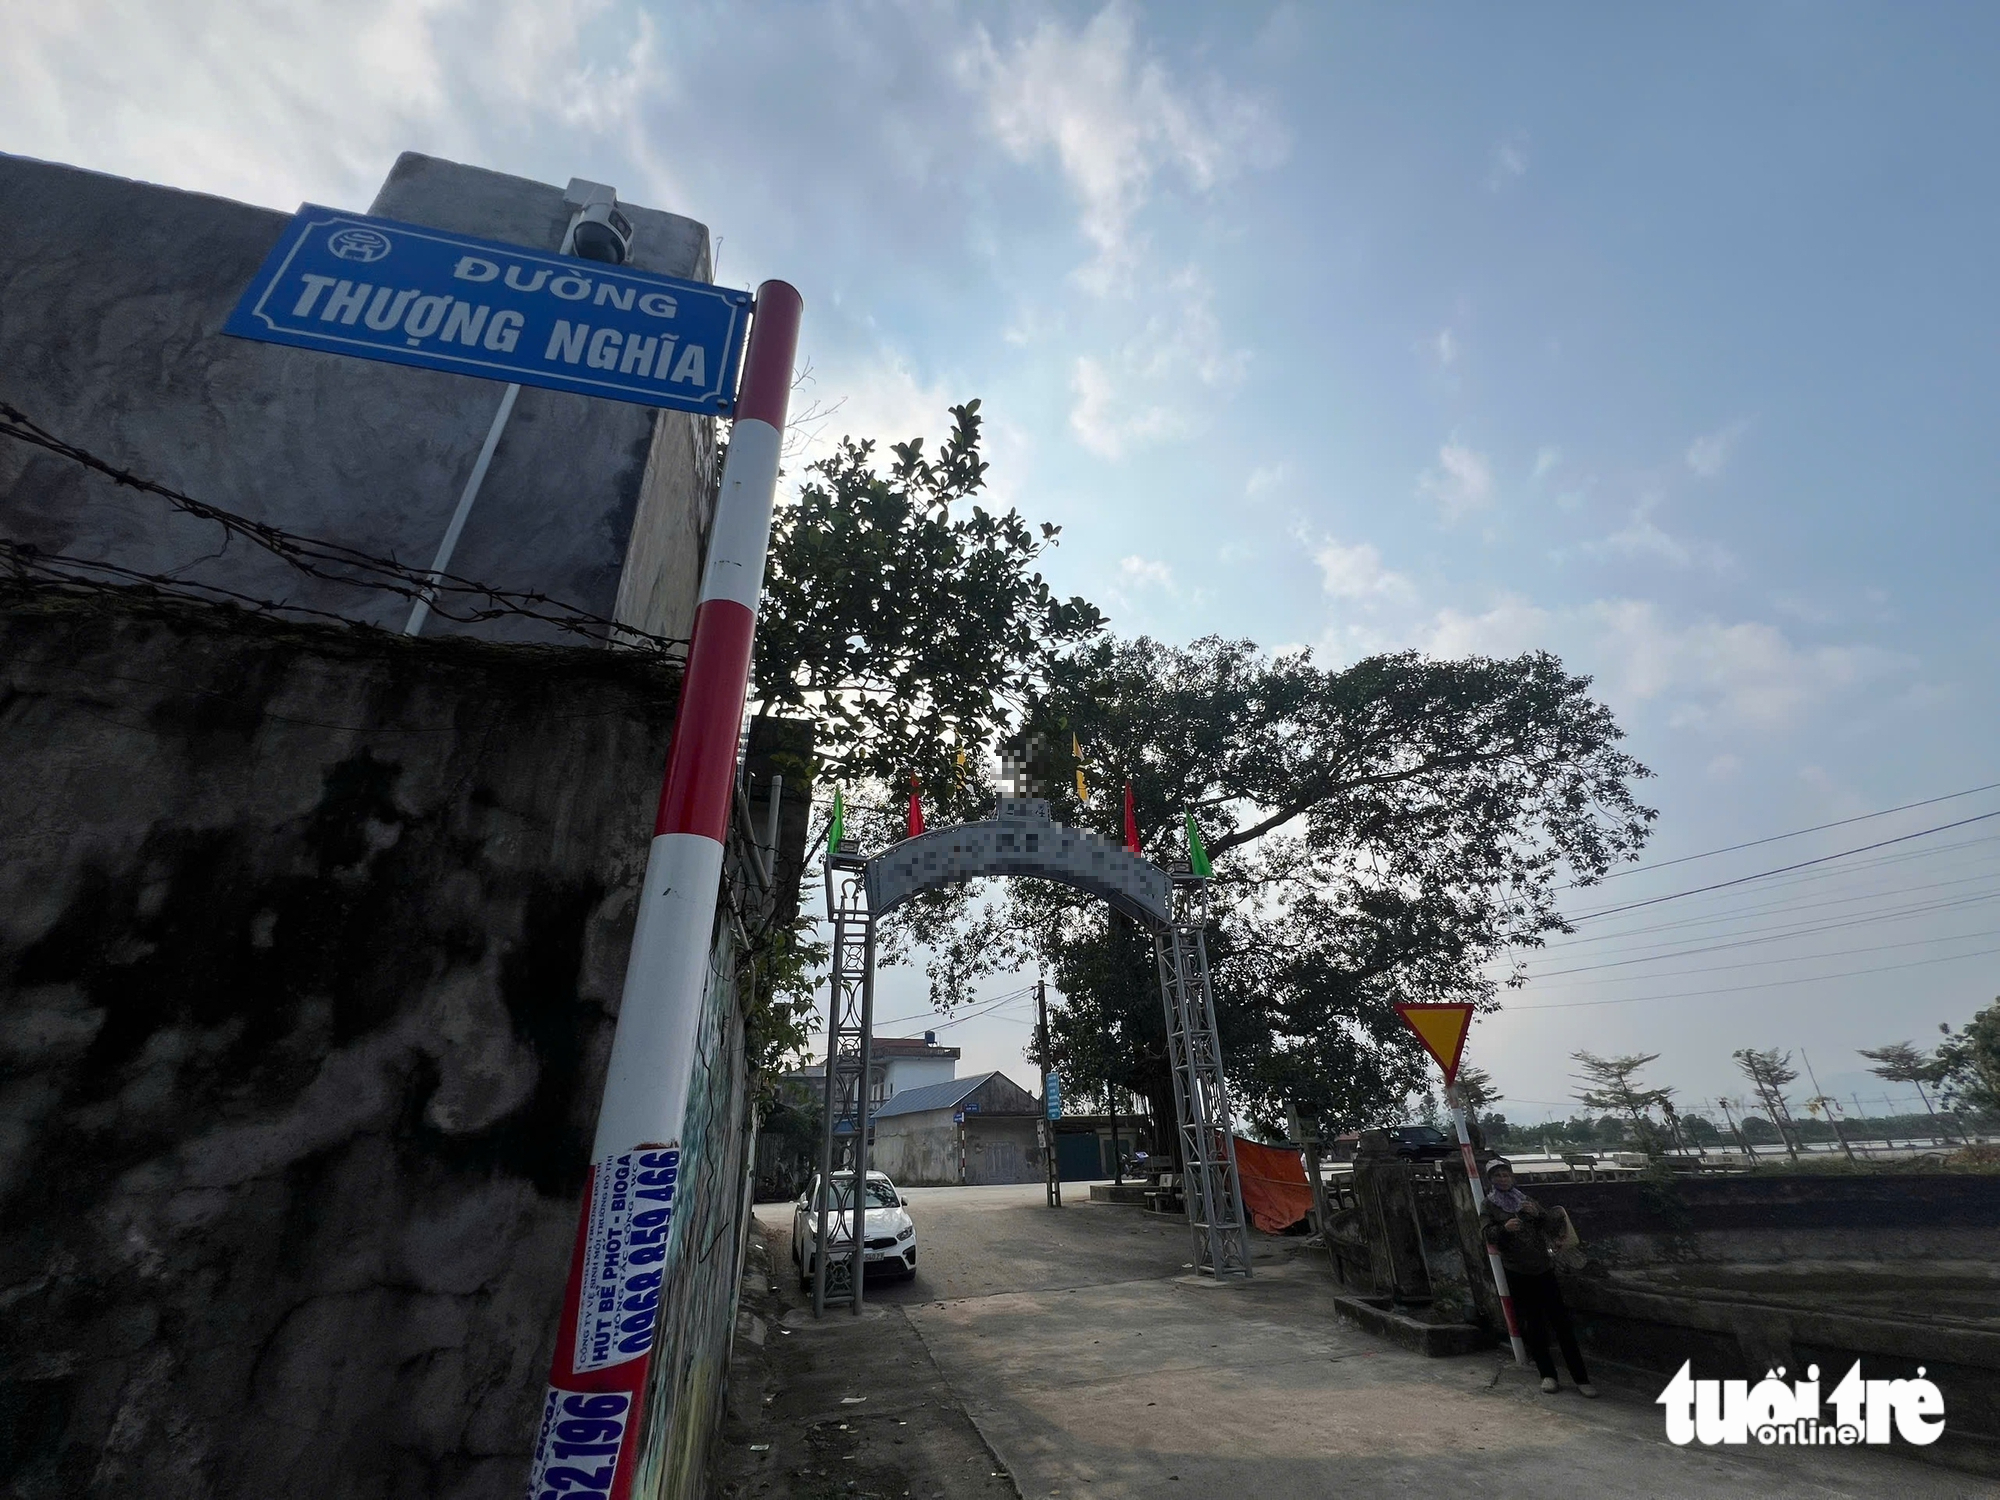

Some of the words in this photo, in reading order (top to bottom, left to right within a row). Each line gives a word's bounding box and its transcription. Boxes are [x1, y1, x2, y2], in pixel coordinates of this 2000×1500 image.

[453, 255, 680, 319] ĐƯỜNG
[292, 273, 525, 353] THƯỢNG
[544, 317, 707, 387] NGHĨA
[611, 1153, 631, 1211] BIOGA
[602, 1227, 622, 1280] PHỐT
[590, 1319, 612, 1361] HÚT
